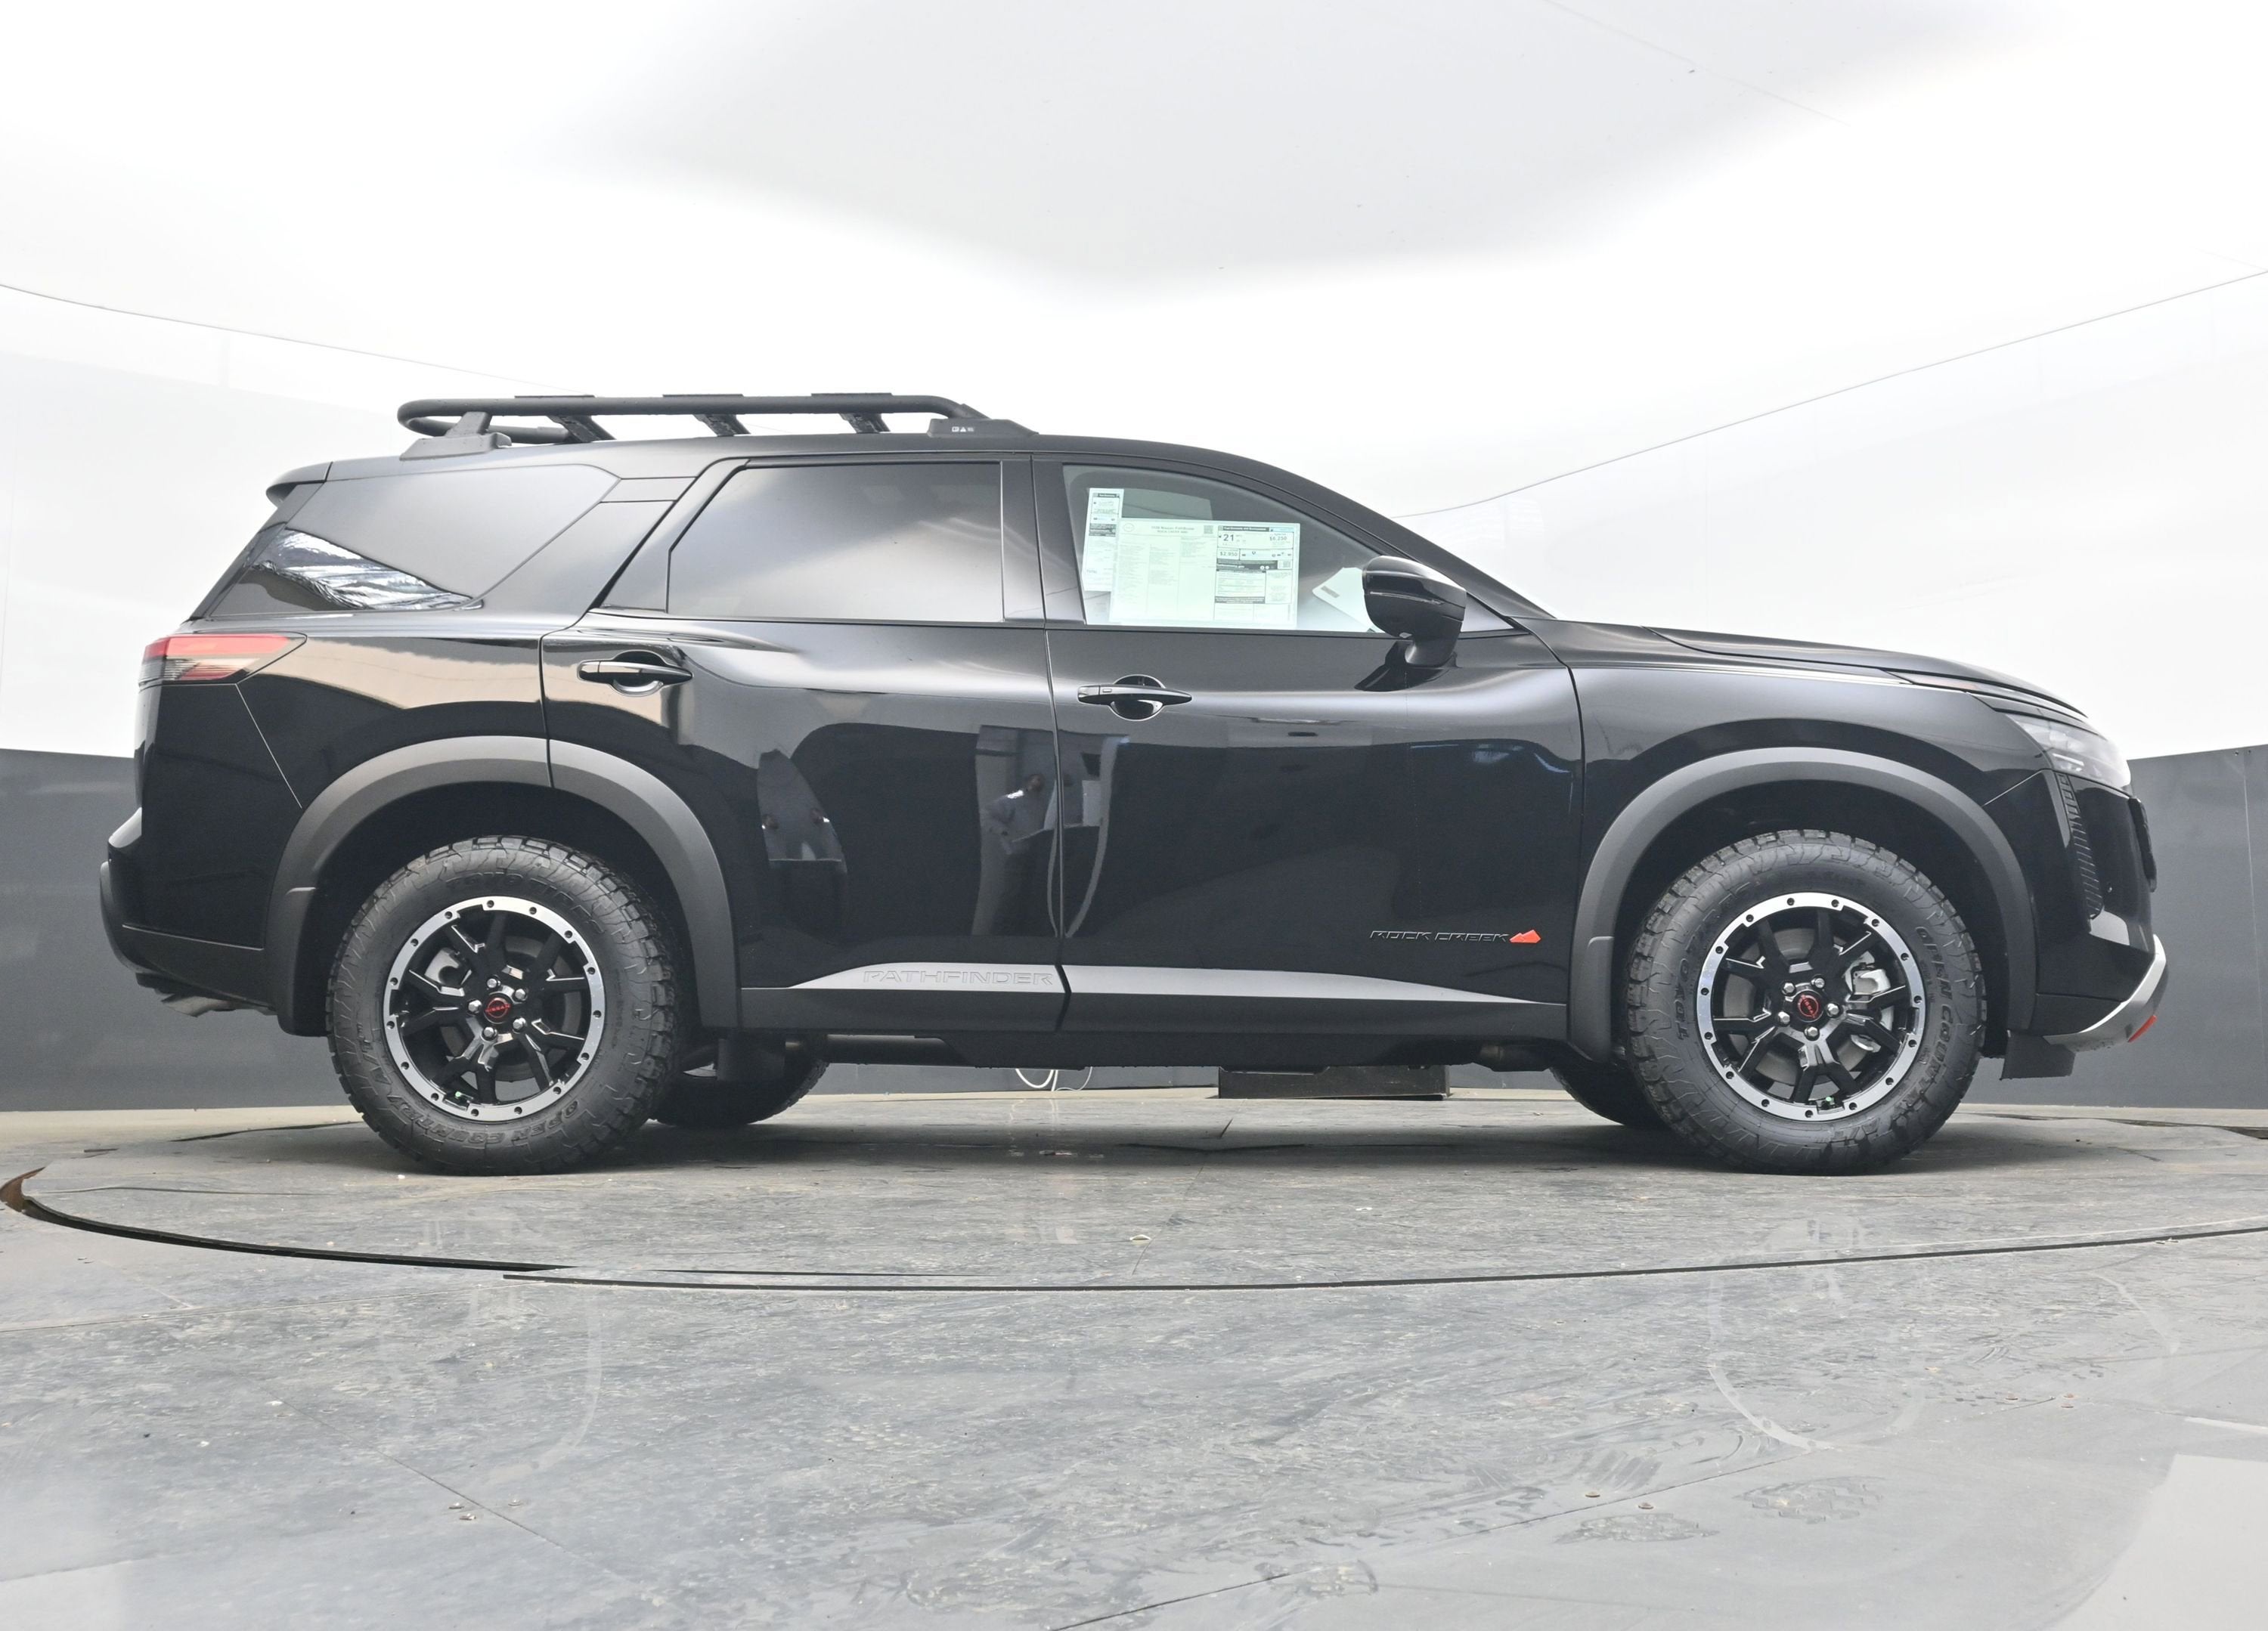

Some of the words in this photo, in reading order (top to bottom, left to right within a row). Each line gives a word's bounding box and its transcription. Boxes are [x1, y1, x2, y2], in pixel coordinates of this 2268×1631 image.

[1223, 534, 1234, 542] 21
[1369, 930, 1433, 941] ROCK
[1434, 932, 1509, 942] CREEK
[1915, 927, 1953, 1000] OPEN
[863, 970, 1054, 986] PATHFINDER
[387, 1094, 506, 1144] COUNTRY
[511, 1100, 579, 1141] OPEN
